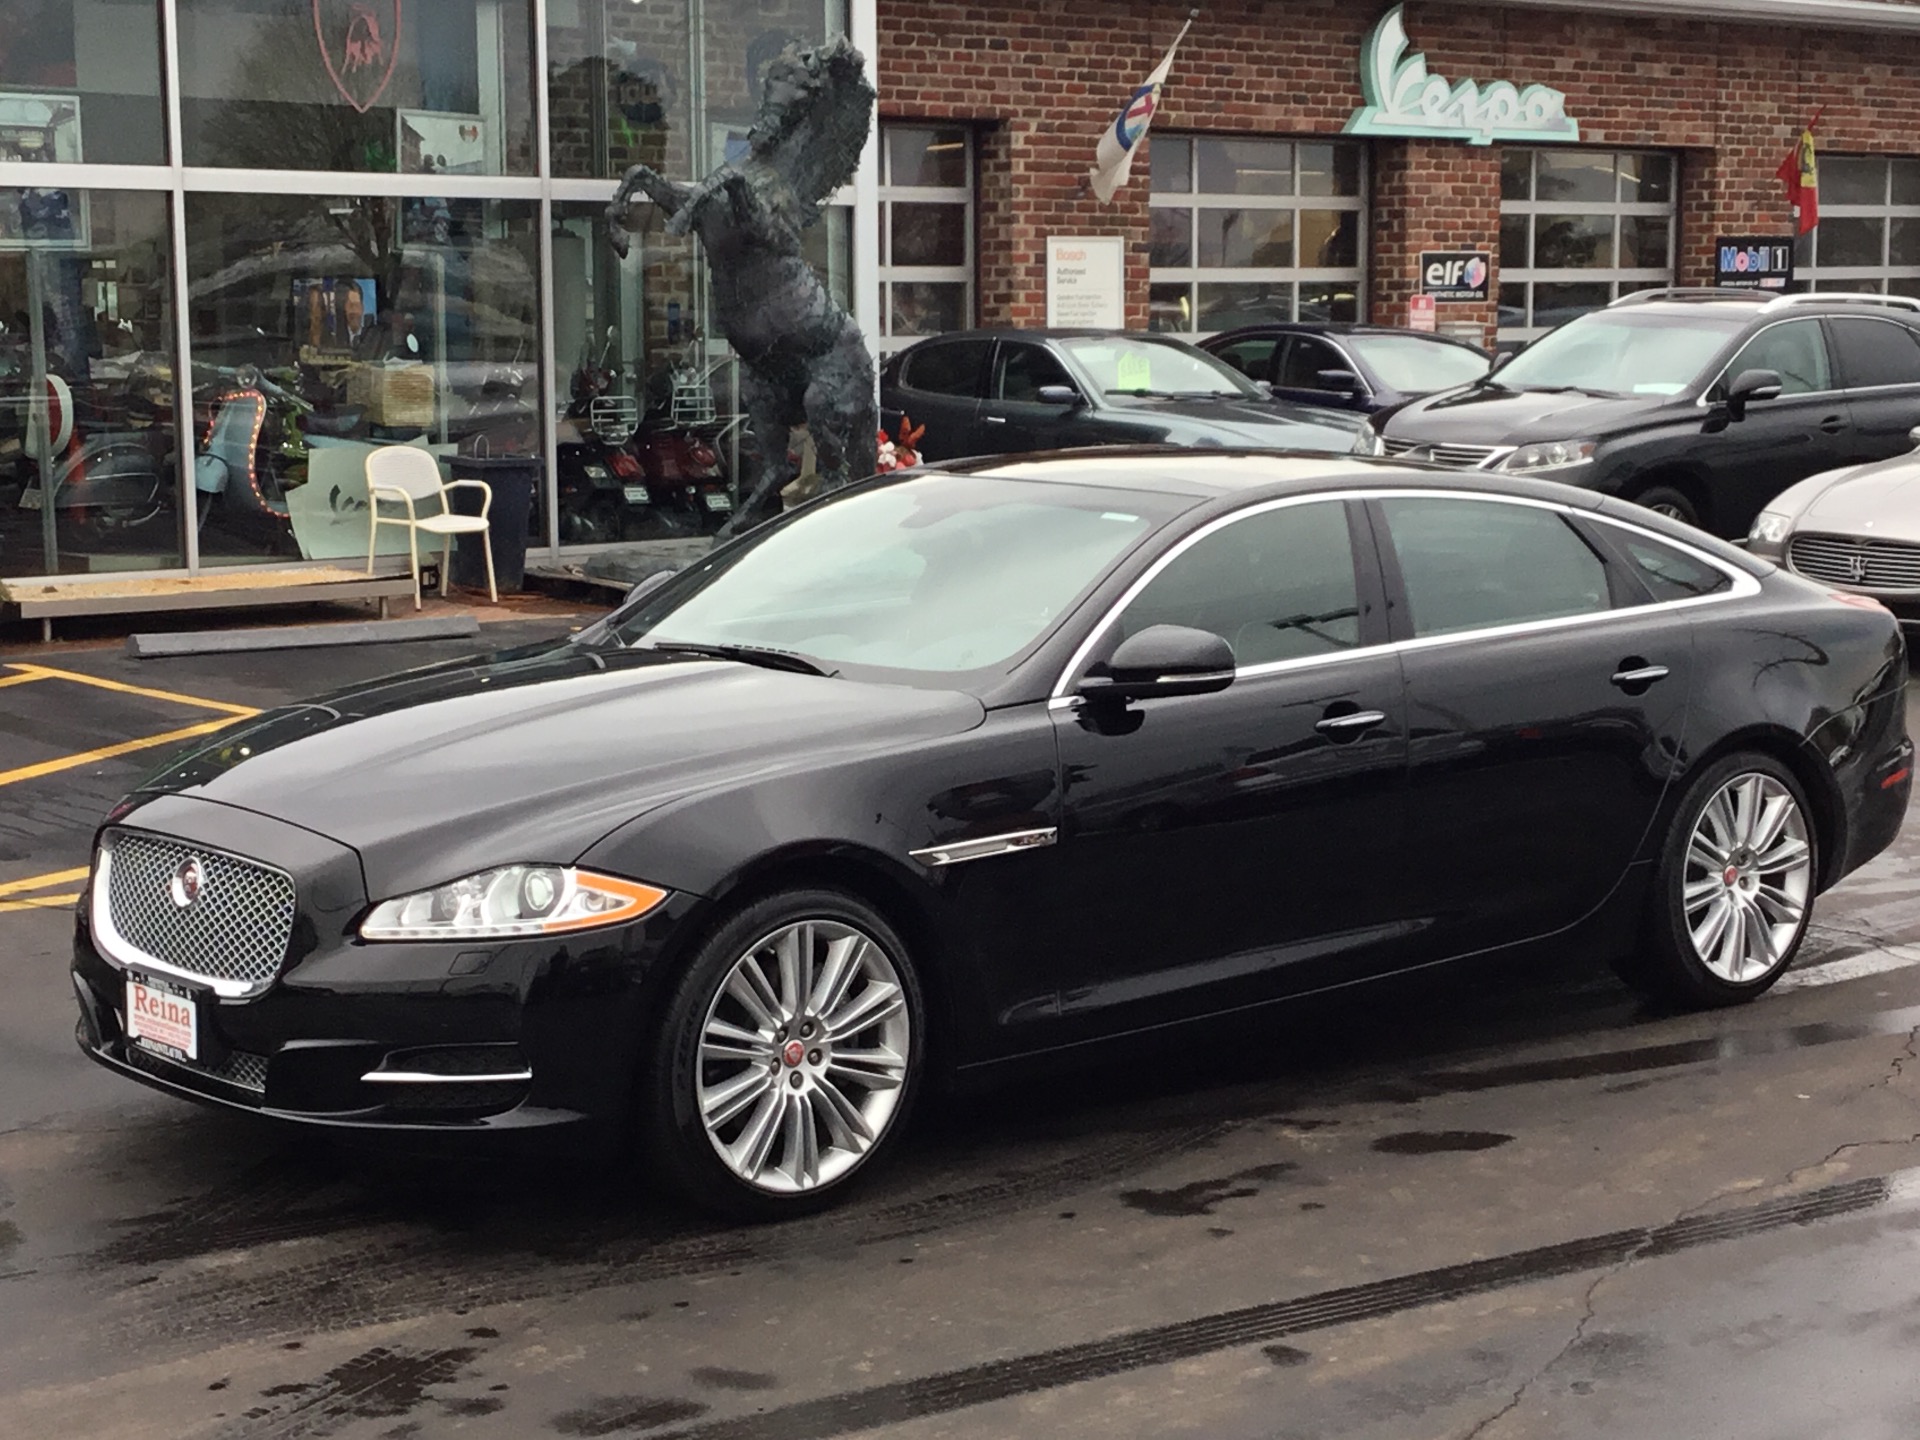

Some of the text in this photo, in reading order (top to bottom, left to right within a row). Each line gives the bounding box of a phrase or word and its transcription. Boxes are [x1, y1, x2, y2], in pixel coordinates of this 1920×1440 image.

[1363, 6, 1574, 141] Vespa
[1056, 248, 1087, 261] Bosch
[1720, 246, 1769, 272] Mobil
[1426, 260, 1464, 286] elf
[134, 985, 191, 1029] Reina
